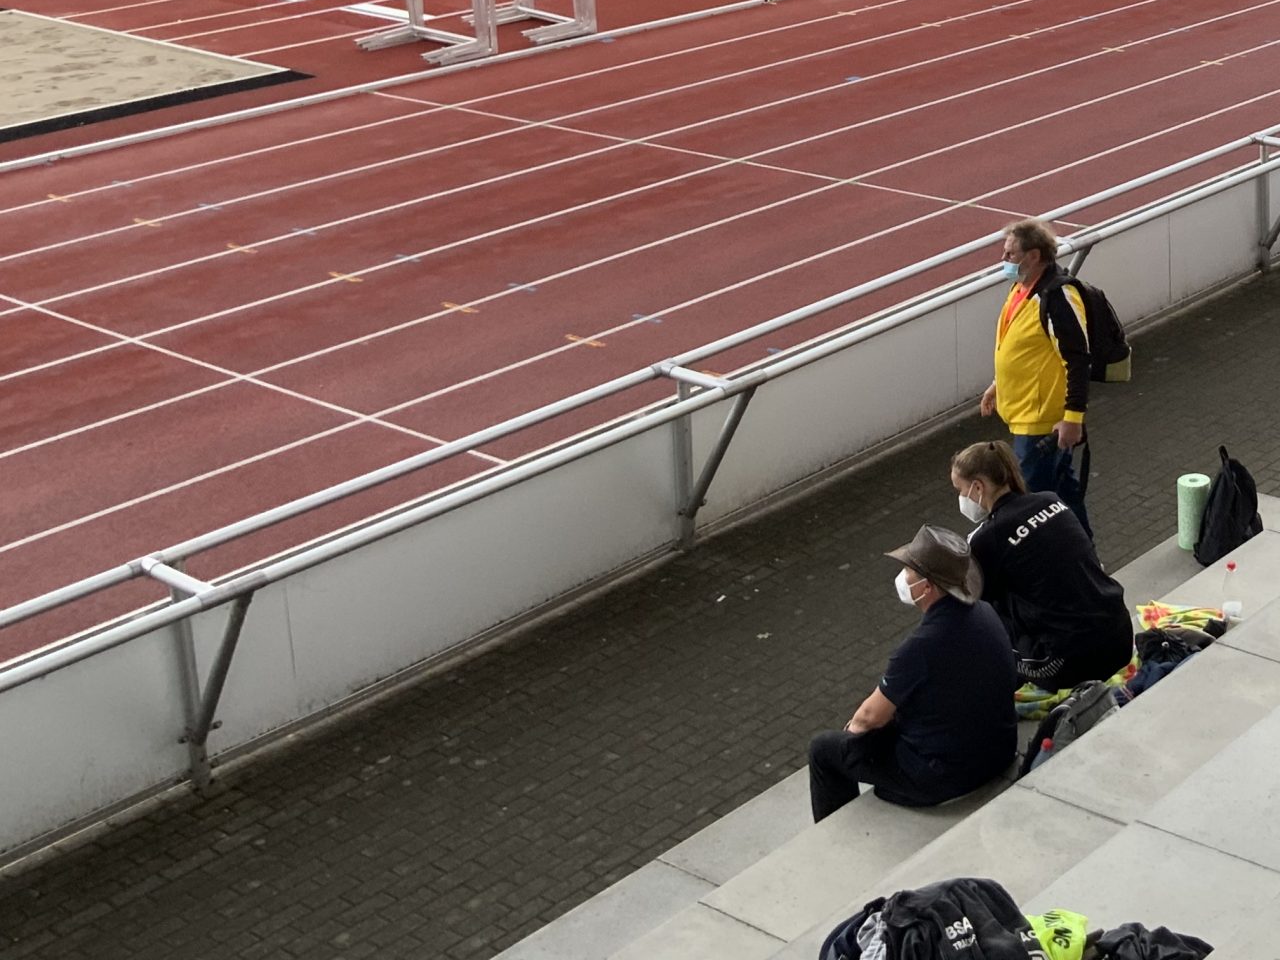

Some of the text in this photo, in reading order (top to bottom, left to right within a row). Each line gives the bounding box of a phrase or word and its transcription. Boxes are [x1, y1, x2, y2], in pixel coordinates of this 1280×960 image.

[1007, 500, 1069, 546] LG FULDA
[944, 916, 974, 940] BSA
